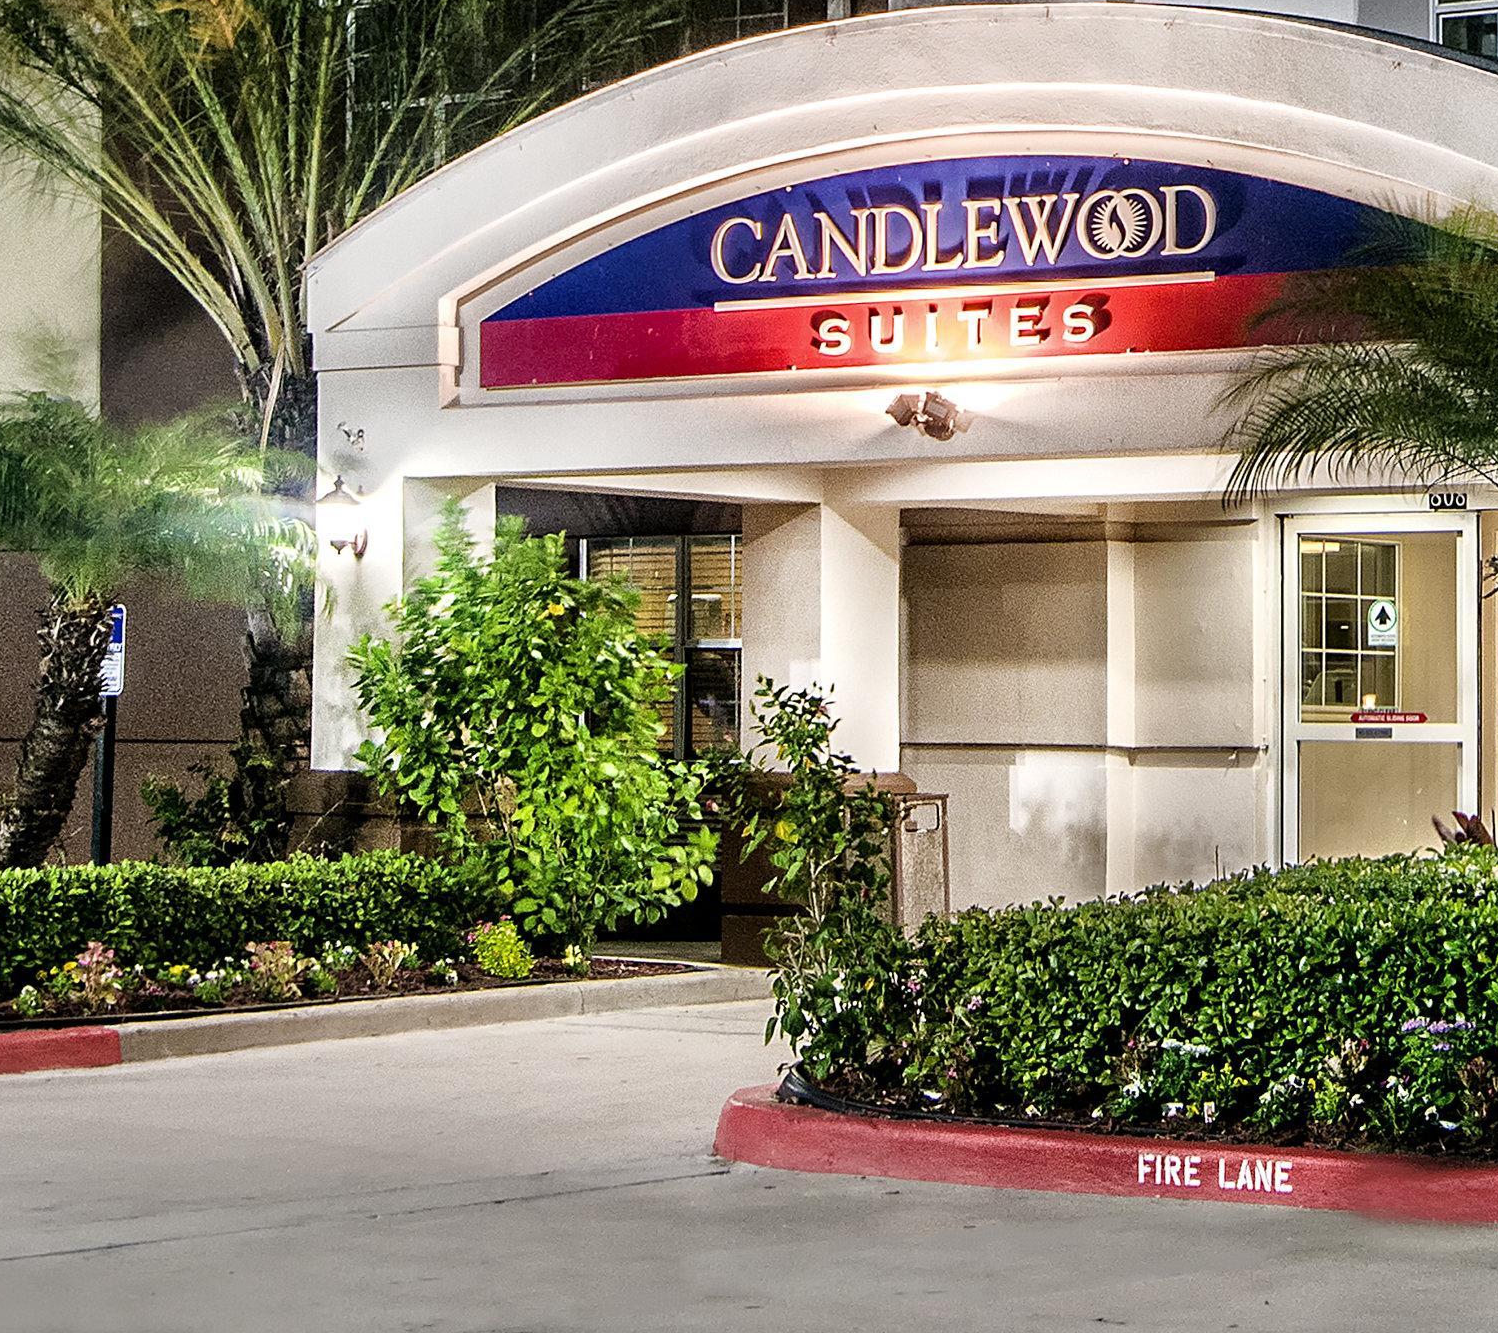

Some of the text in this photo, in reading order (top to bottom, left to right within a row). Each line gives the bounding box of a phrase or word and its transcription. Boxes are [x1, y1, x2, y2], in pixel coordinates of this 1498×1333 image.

[711, 185, 1217, 285] CANDLEWOOD
[818, 304, 1097, 356] SUITES
[1137, 1153, 1293, 1193] FIRE LANE
